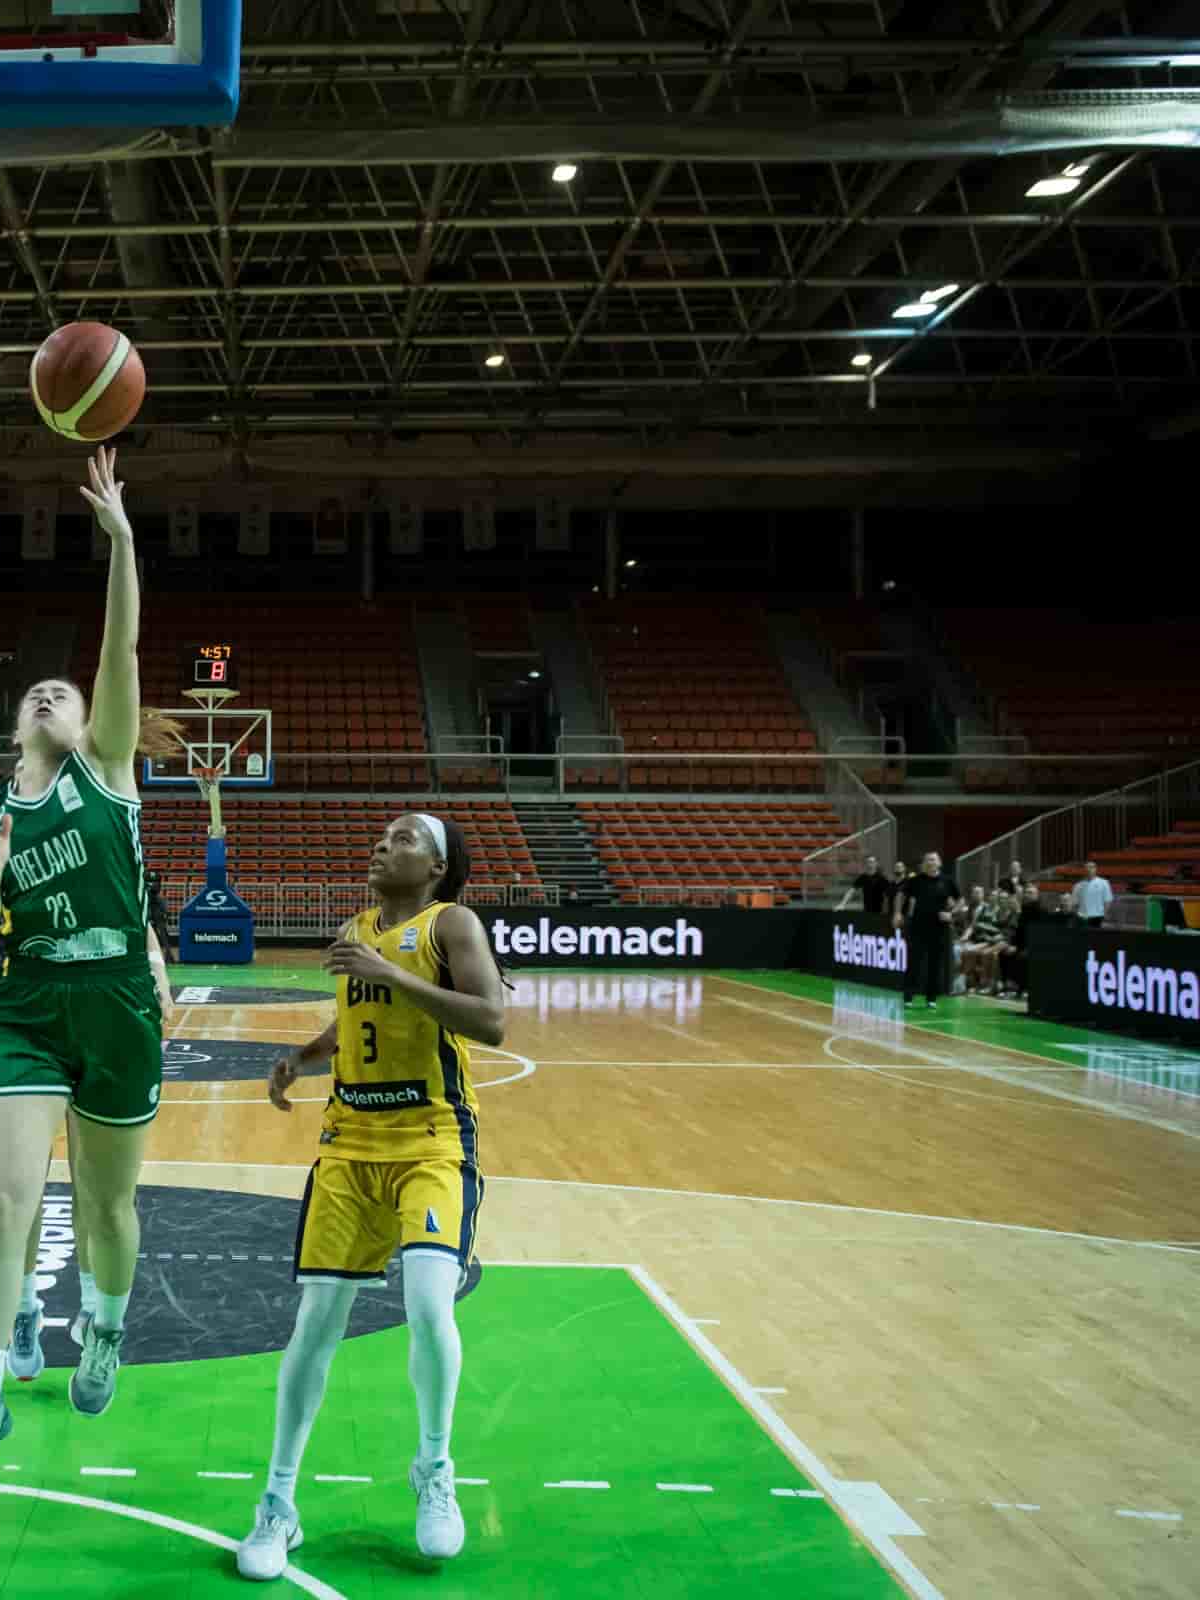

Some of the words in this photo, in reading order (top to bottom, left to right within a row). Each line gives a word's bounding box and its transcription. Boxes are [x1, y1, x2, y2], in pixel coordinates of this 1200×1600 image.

[200, 646, 231, 659] 4:57
[211, 661, 225, 680] 8
[8, 829, 88, 891] IRELAND
[491, 917, 703, 956] telemach
[833, 923, 907, 973] telemach
[1086, 949, 1200, 1020] telema
[361, 1021, 378, 1065] 3
